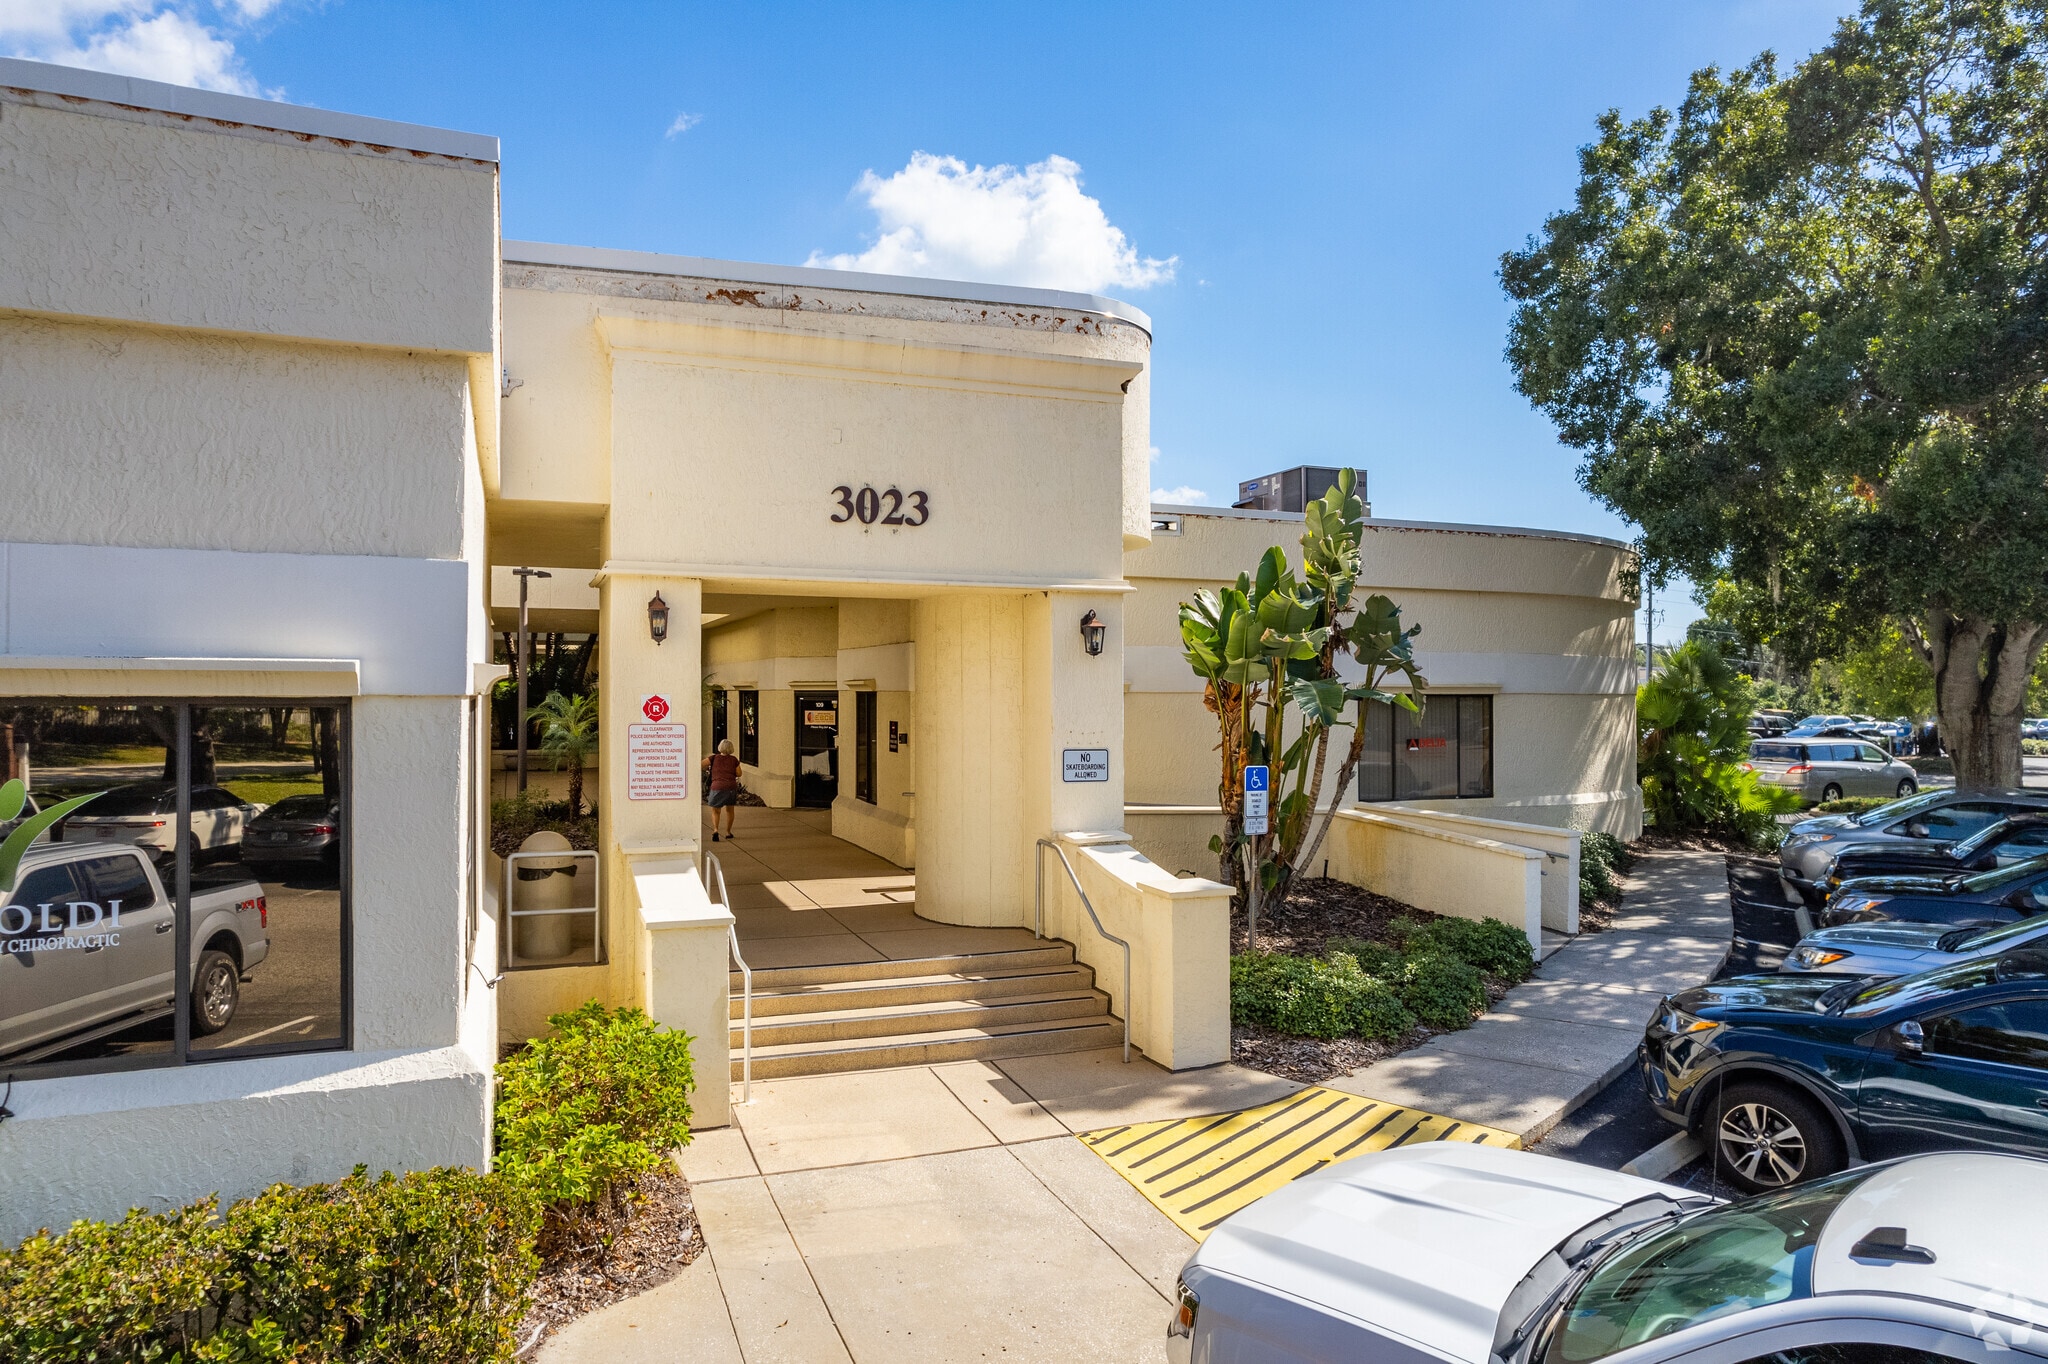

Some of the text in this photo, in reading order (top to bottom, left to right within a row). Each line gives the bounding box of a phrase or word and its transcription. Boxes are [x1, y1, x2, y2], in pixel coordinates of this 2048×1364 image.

[830, 485, 929, 526] 3023
[1080, 753, 1091, 762] NO
[1065, 763, 1106, 771] SKATEBOARDING
[1074, 771, 1098, 779] ALLOWED
[0, 899, 123, 935] OLDI
[7, 933, 120, 953] CHIROPRACTIC
